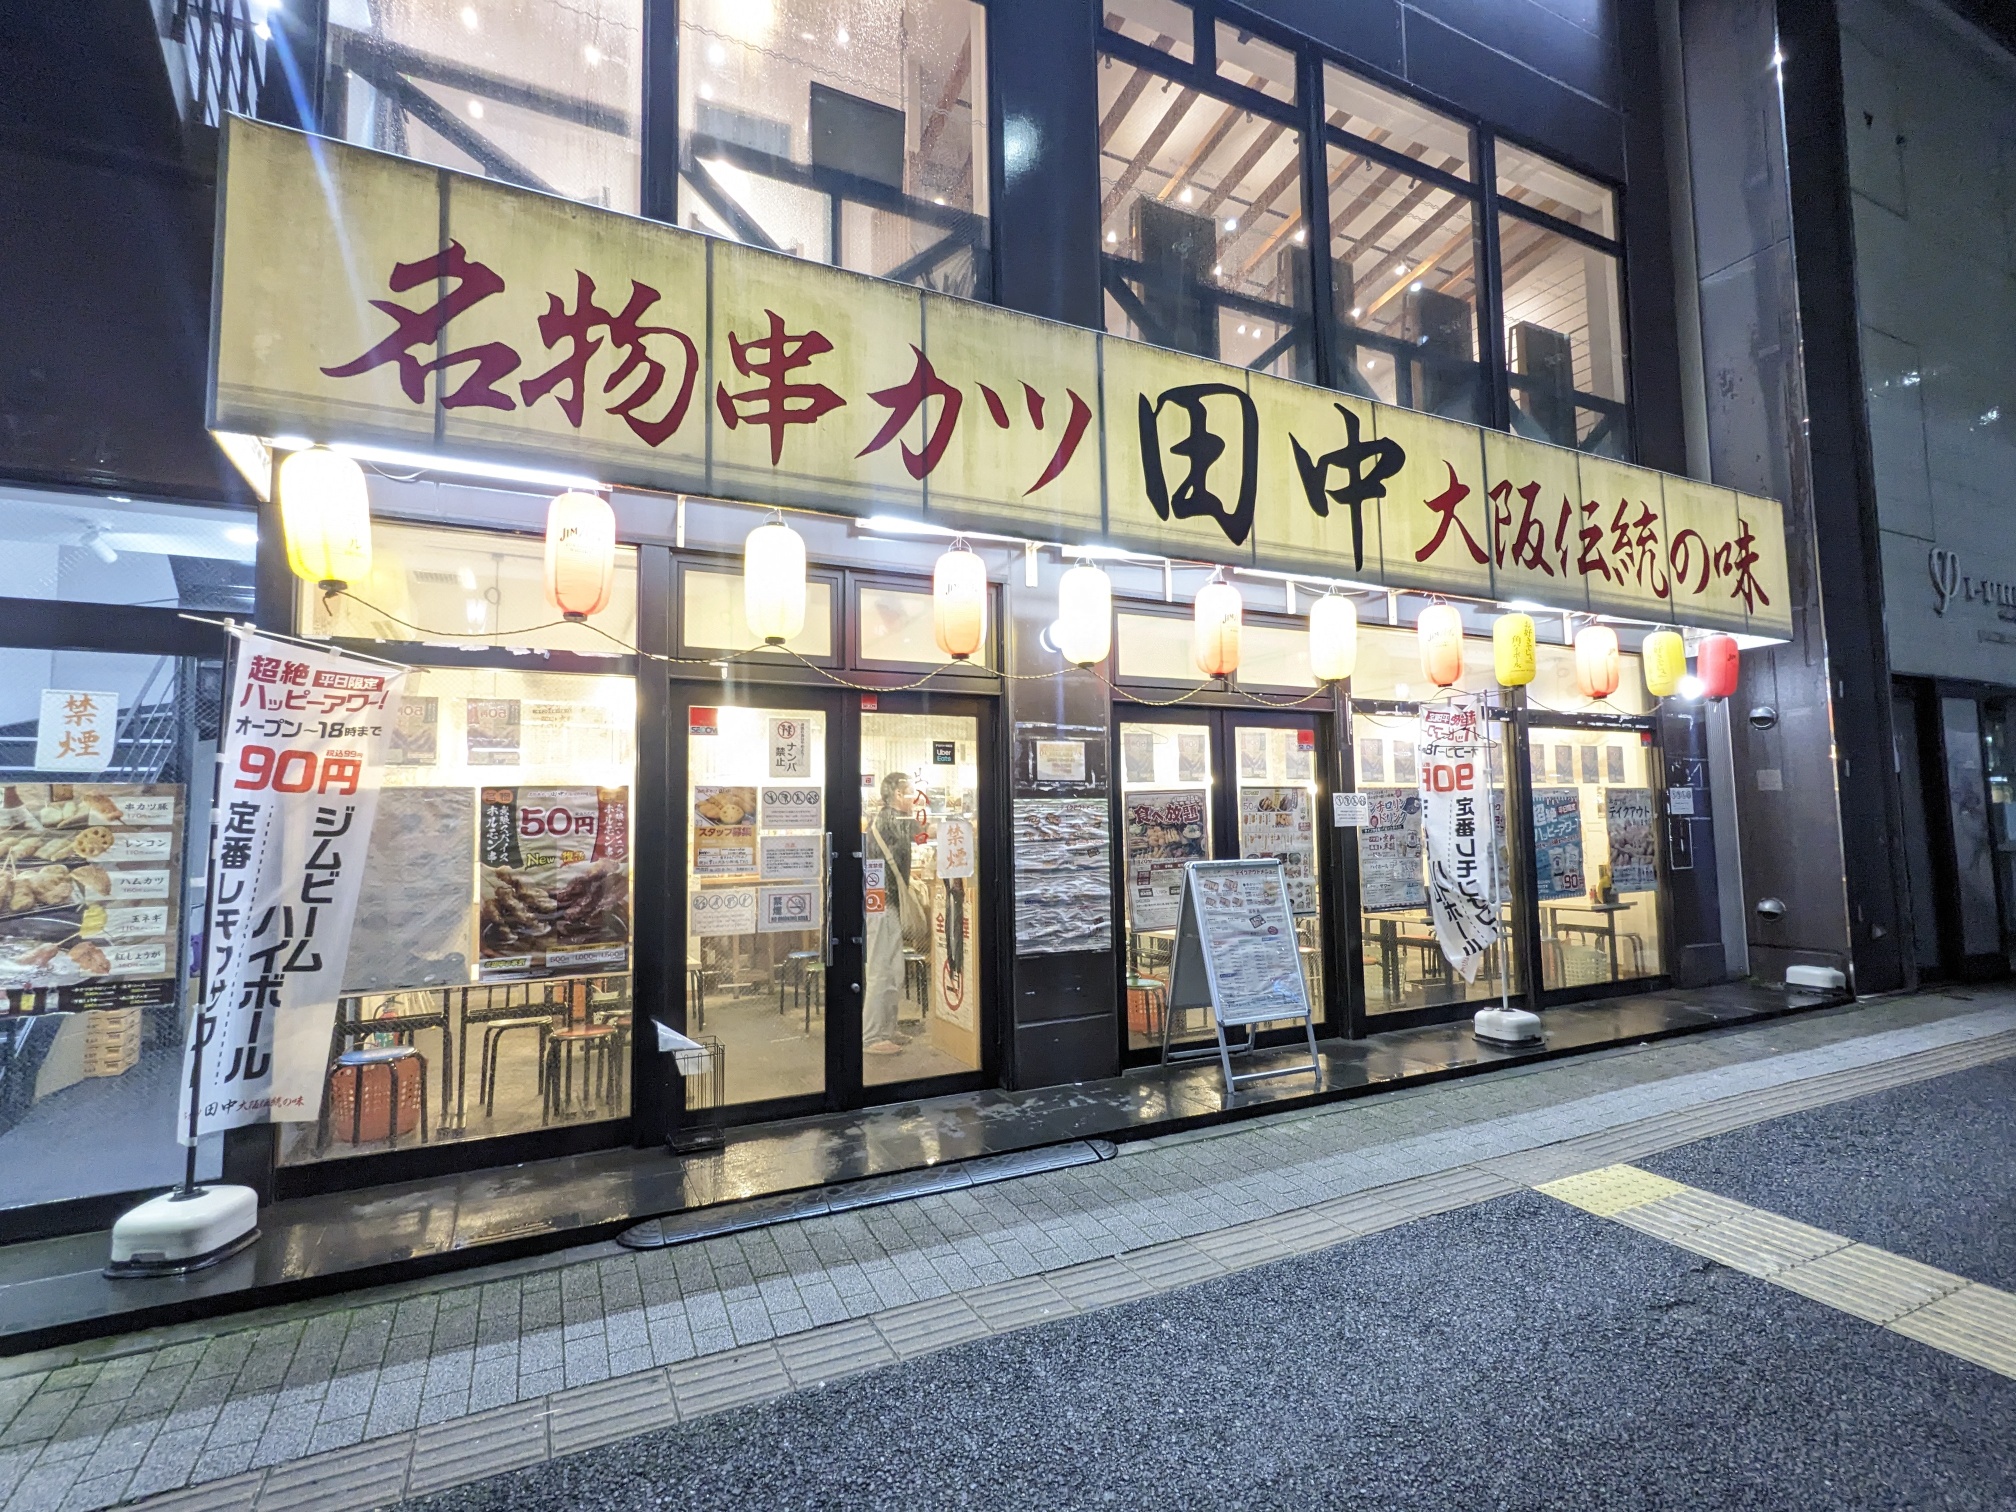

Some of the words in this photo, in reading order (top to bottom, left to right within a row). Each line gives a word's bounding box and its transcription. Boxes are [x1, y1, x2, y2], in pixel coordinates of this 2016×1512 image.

[1415, 459, 1770, 615] 大阪伝統の味
[248, 654, 311, 687] 超絶
[318, 673, 380, 691] 平日限定
[56, 693, 100, 759] 禁煙
[234, 744, 362, 796] 90円
[775, 747, 786, 767] 禁止
[786, 742, 797, 772] ナンパ
[125, 803, 168, 811] 串カツ豚
[521, 807, 594, 836] 50円
[1609, 806, 1650, 818] テイクアウト
[125, 840, 167, 848] レンコン
[486, 805, 499, 864] ホルモン串
[603, 804, 615, 858] ホルモン串
[698, 827, 752, 838] スタッフ募集
[945, 823, 968, 870] 禁煙
[527, 853, 556, 867] New
[121, 877, 164, 885] ハムカツ
[282, 805, 355, 973] ジムビーム
[115, 951, 161, 961] 紅しょうが
[189, 800, 260, 1089] 定番レモンサワ
[224, 905, 294, 1084] ハイボール
